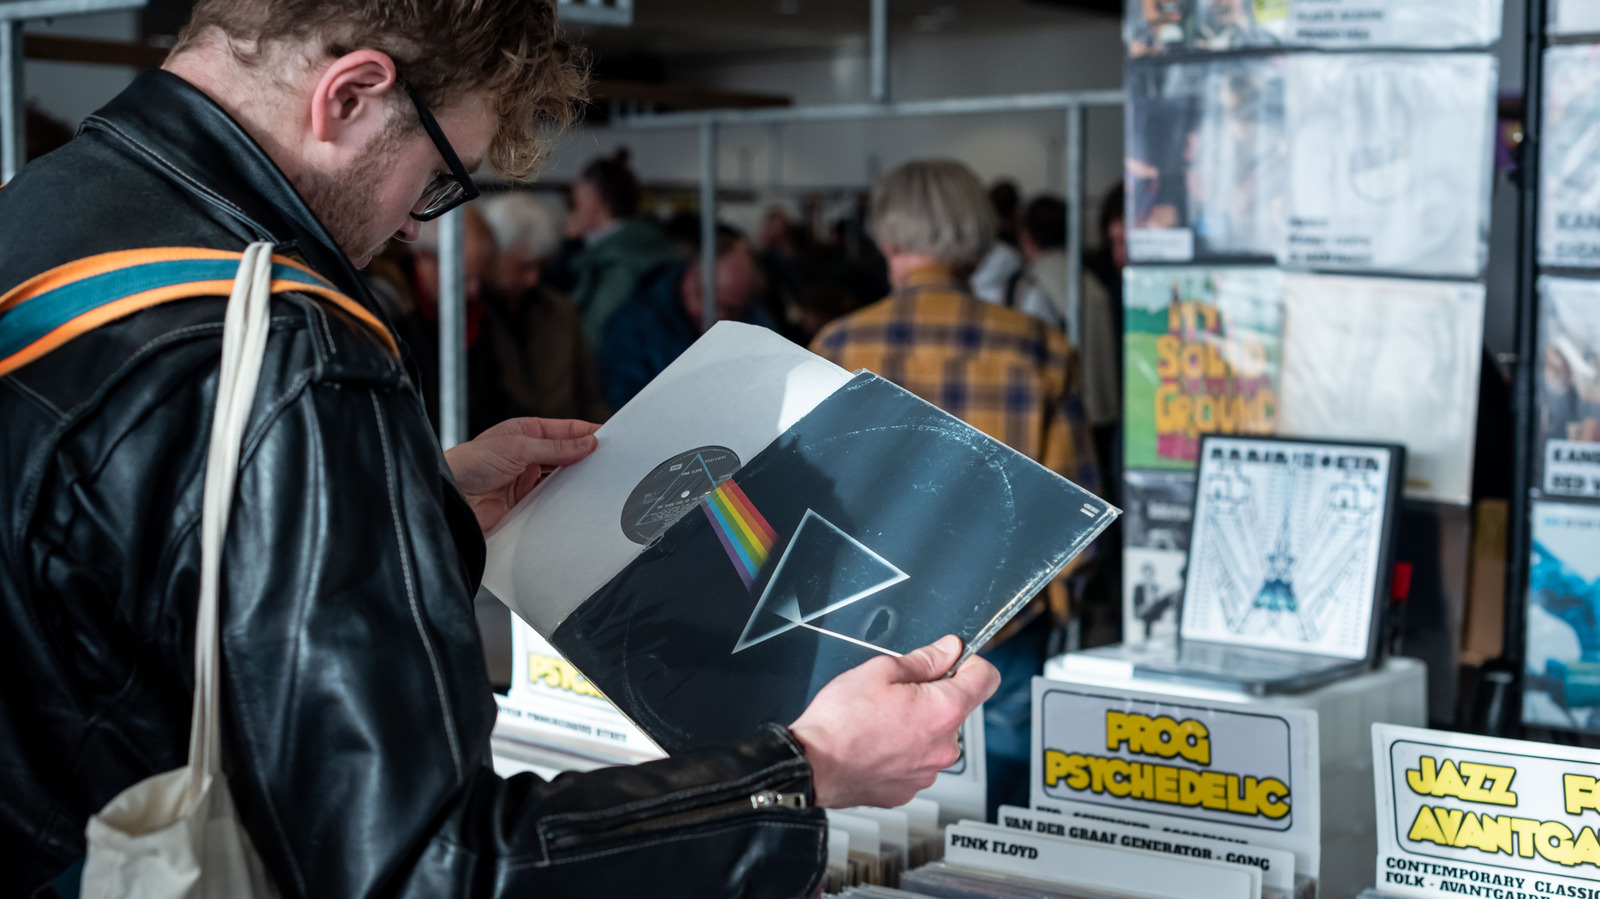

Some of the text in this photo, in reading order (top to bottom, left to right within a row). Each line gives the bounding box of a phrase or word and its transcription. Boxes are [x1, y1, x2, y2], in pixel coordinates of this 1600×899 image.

[1106, 709, 1211, 765] PROG
[1044, 749, 1292, 820] PSYCHEDELIC
[1406, 755, 1518, 807] JAZZ
[951, 834, 1038, 860] PINK FLOYD
[1004, 816, 1033, 832] VAN
[1037, 822, 1065, 837] DER
[1069, 826, 1118, 845] GRAAF
[1121, 835, 1212, 860] GENERATOR
[1226, 852, 1270, 871] GONG
[1407, 805, 1600, 868] AVANTGA
[1386, 857, 1526, 889] CONTEMPORARY
[1386, 871, 1424, 888] FOLK
